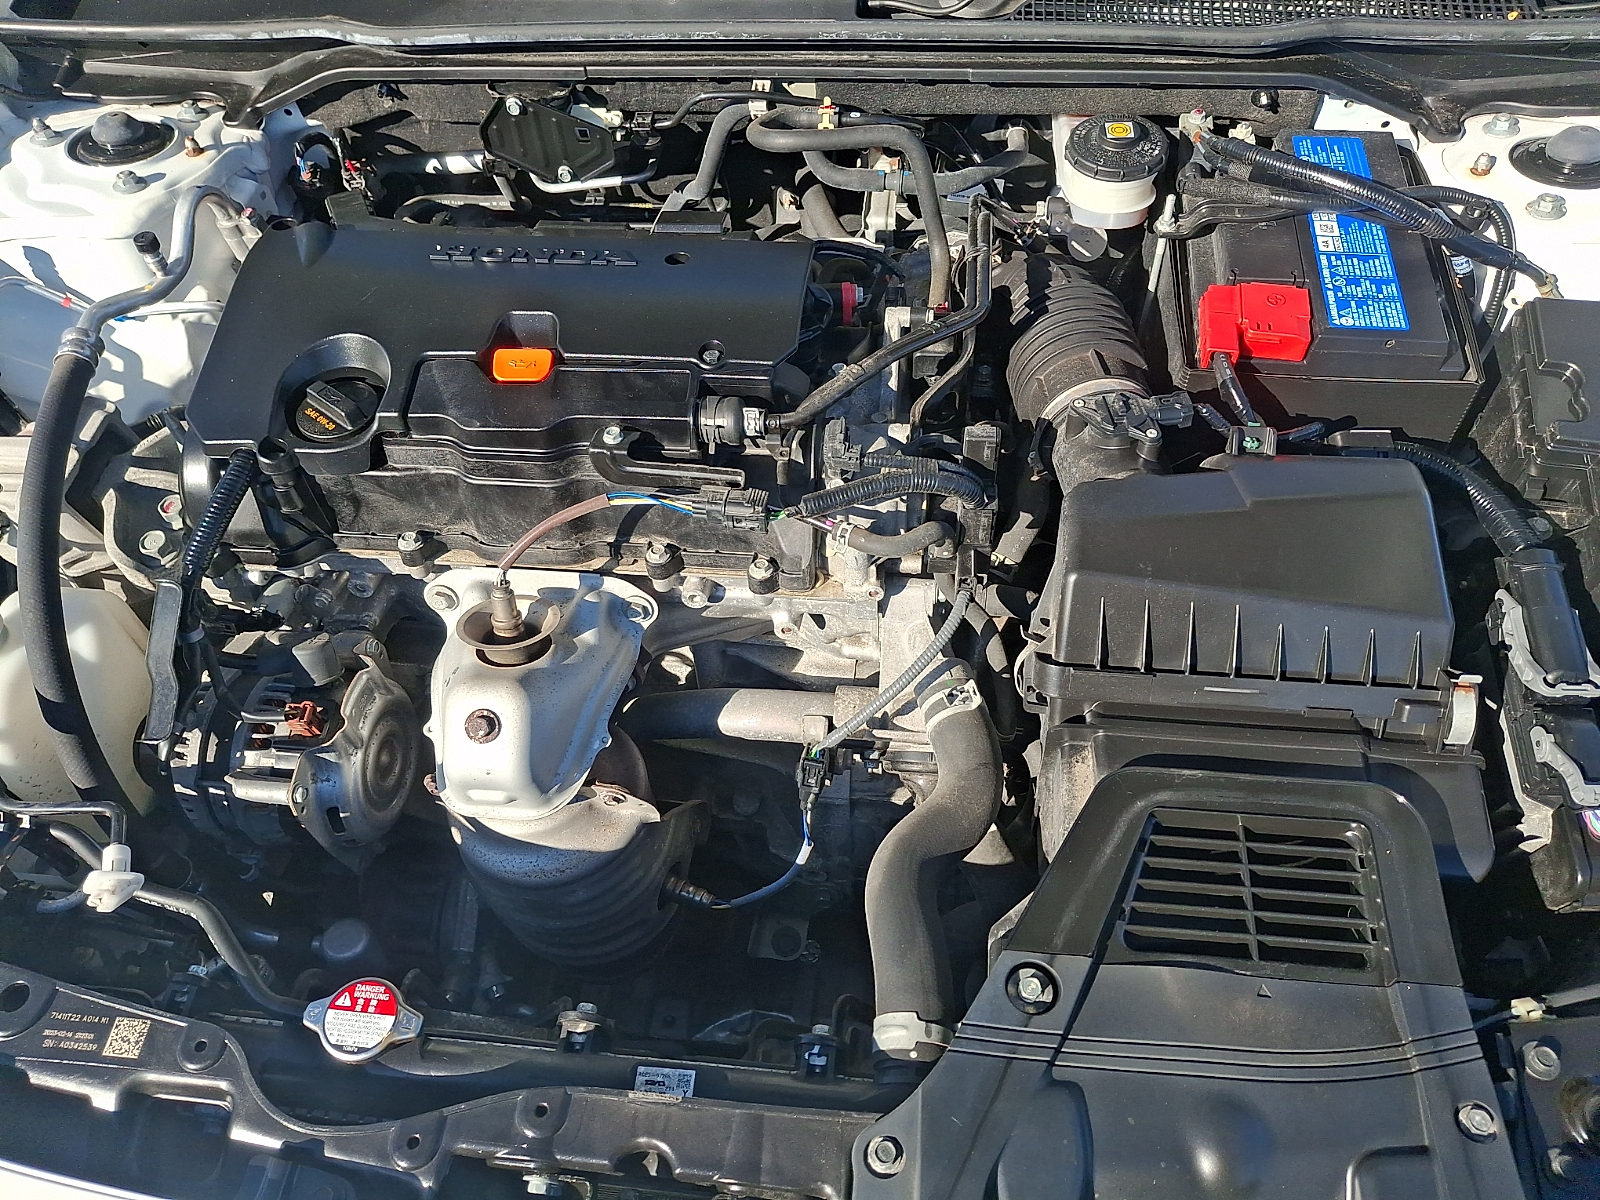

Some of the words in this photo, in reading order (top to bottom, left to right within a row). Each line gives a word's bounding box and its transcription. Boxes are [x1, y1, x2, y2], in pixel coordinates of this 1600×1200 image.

[1321, 240, 1330, 249] 4A
[429, 244, 638, 267] HONDA
[305, 408, 320, 419] SAE
[317, 416, 336, 431] 0W-20
[355, 984, 385, 993] DANGER
[354, 990, 389, 1000] WARNUNG
[82, 1015, 99, 1023] A014
[42, 1039, 58, 1048] SN:
[58, 1041, 98, 1051] A0342539
